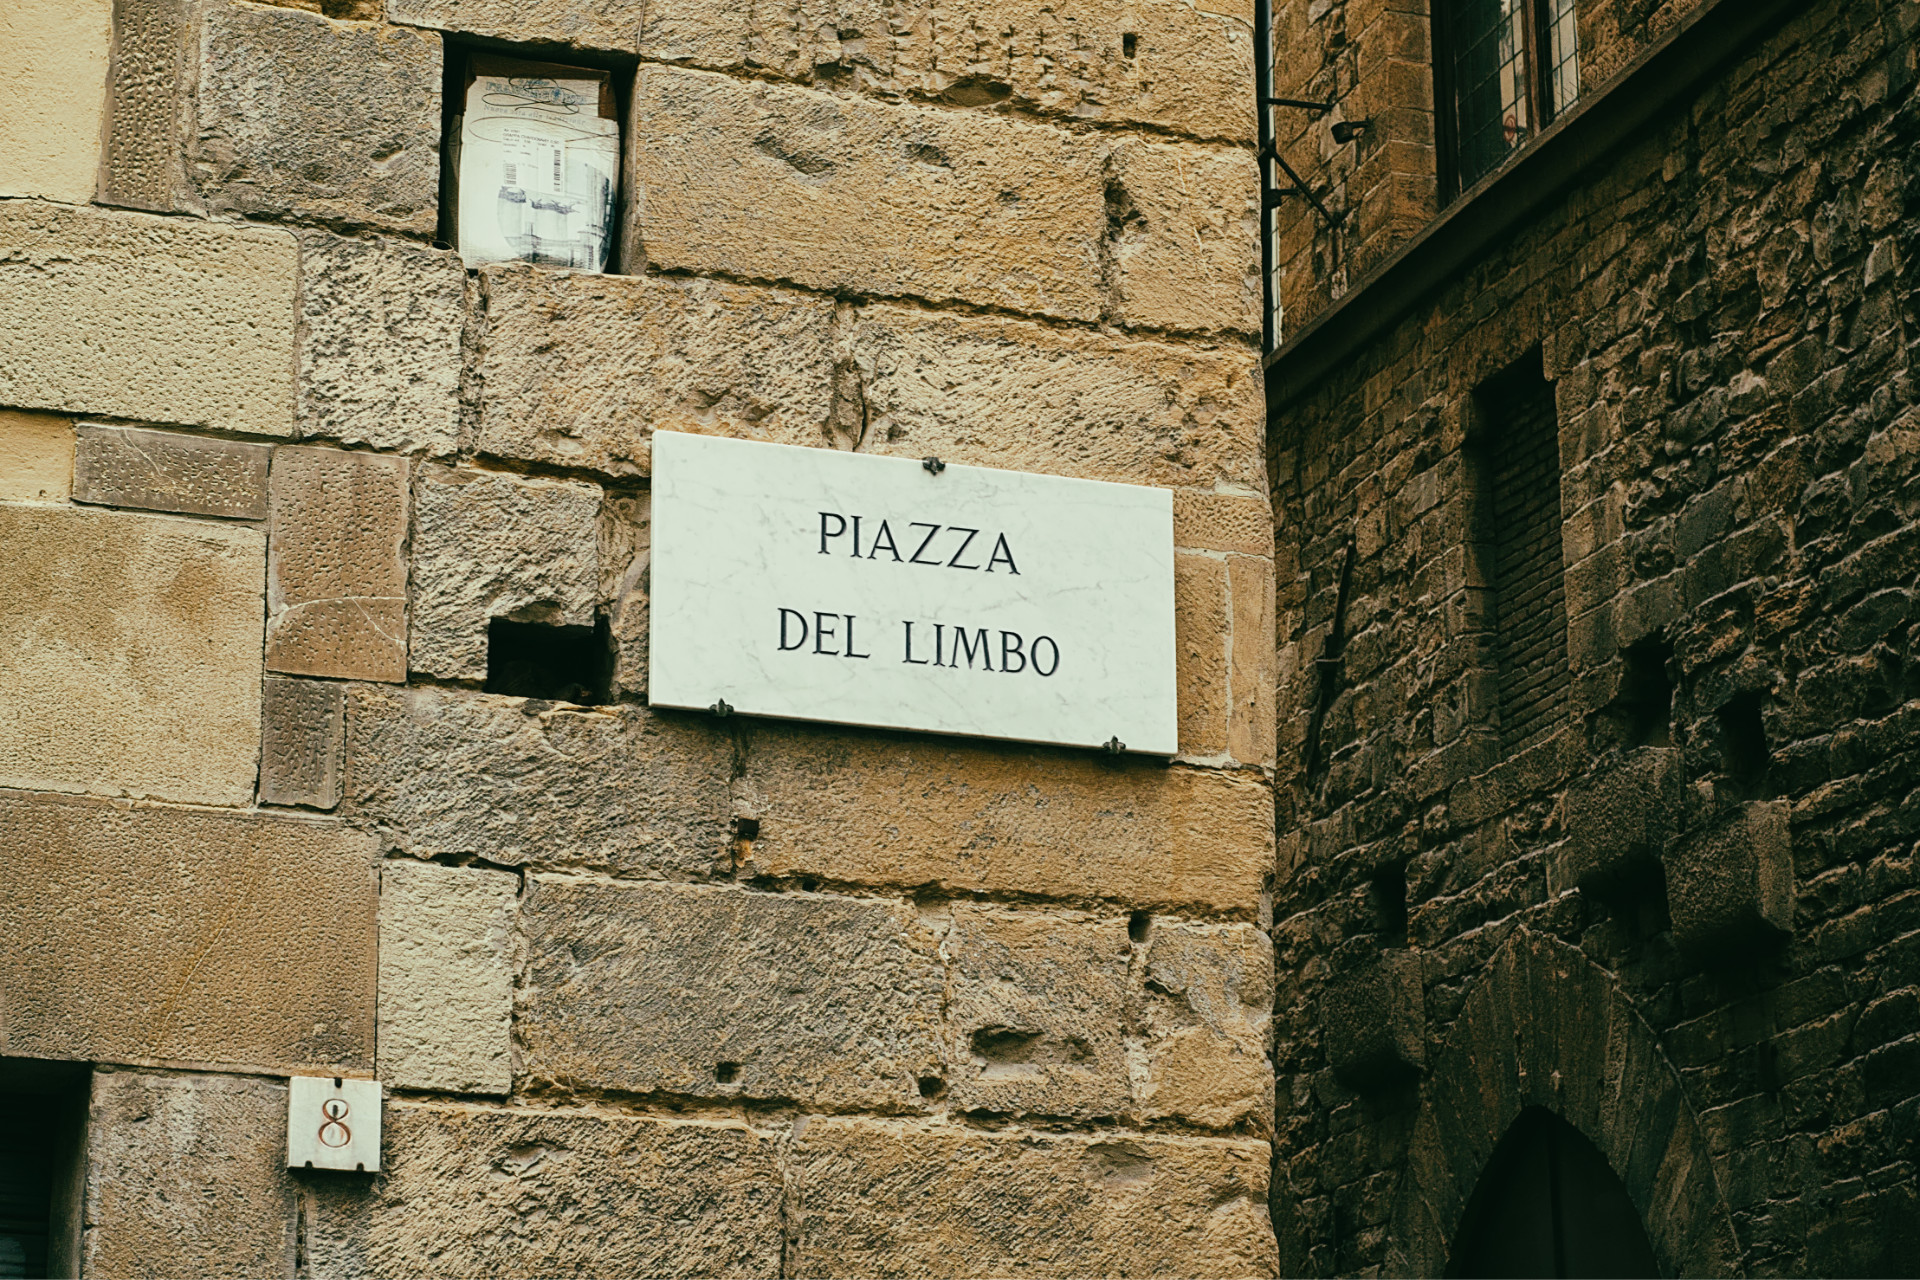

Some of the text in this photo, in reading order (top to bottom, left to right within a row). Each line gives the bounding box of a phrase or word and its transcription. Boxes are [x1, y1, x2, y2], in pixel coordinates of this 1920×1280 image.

[817, 511, 1021, 576] PIAZZA
[777, 607, 1060, 677] DEL LIMBO
[318, 1098, 351, 1148] 8
